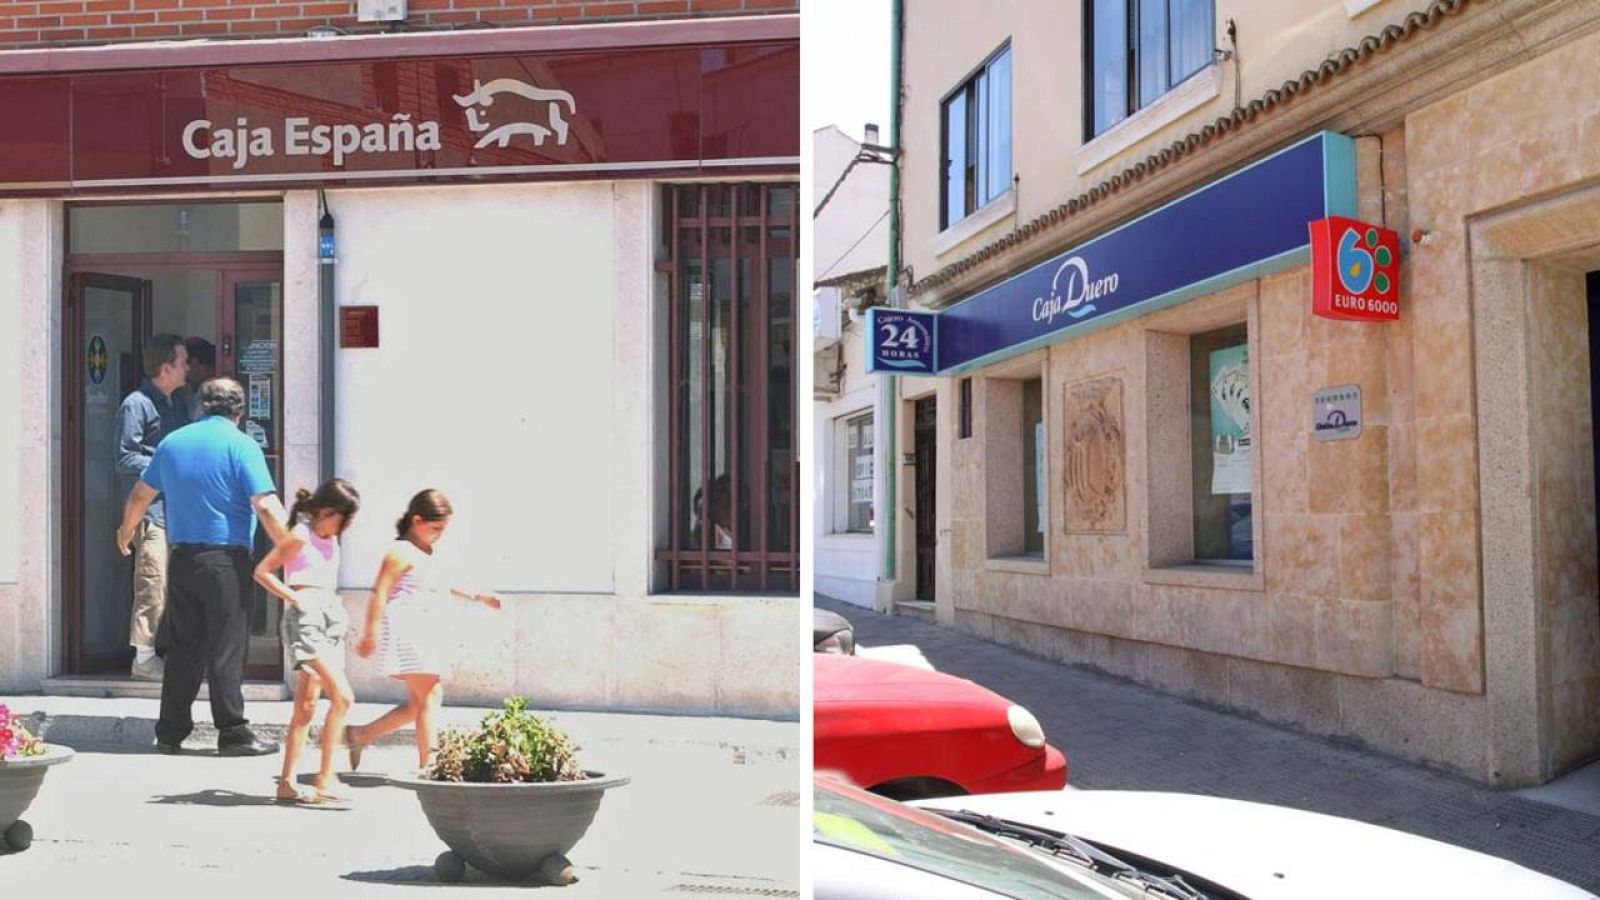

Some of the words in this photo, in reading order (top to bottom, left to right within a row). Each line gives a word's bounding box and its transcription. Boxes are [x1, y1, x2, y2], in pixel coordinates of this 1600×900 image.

[181, 117, 275, 170] Caja
[284, 113, 442, 166] España
[1032, 290, 1062, 325] Caja
[1052, 256, 1119, 312] Duero
[1335, 294, 1366, 310] EURO
[1367, 298, 1398, 315] 6000
[880, 323, 920, 349] 24
[881, 349, 920, 359] HORAS
